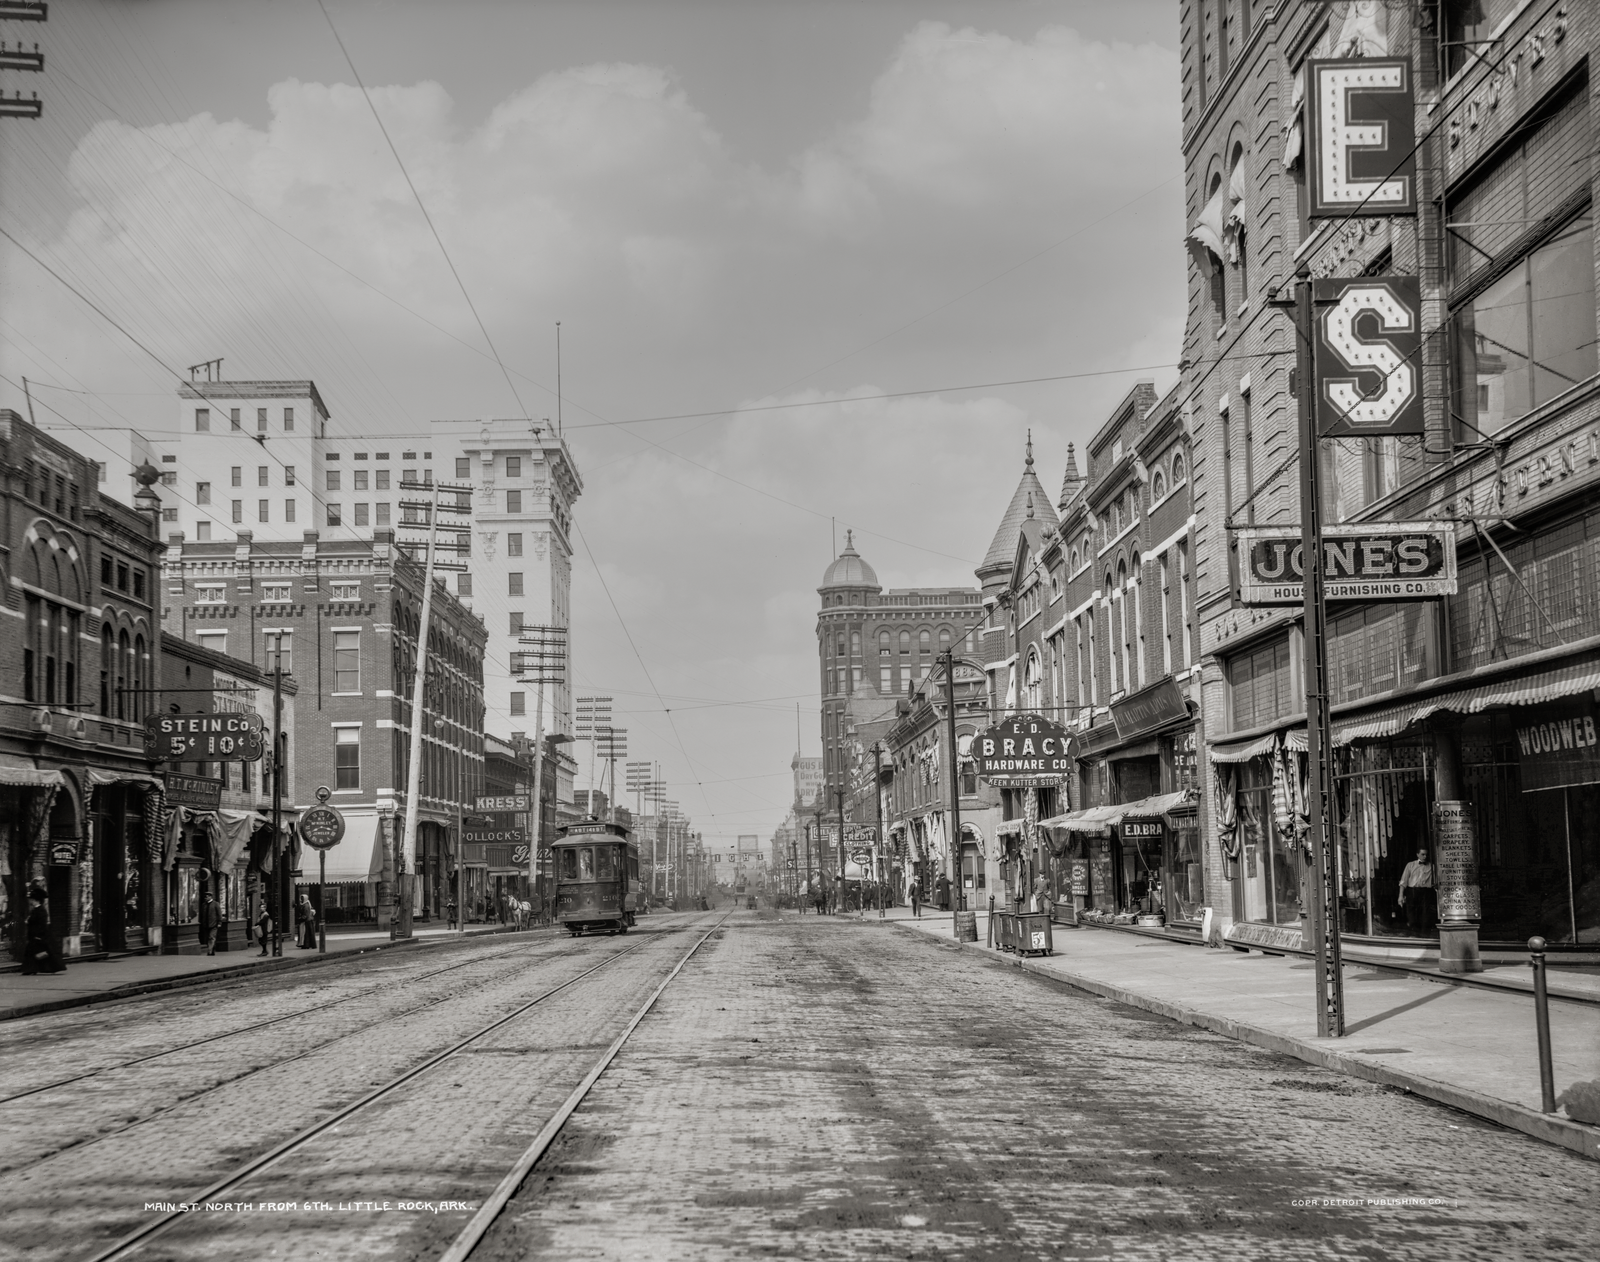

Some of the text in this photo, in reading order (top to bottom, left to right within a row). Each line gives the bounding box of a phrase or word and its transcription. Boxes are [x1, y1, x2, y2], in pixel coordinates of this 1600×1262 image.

[1406, 583, 1426, 593] CO.
[161, 719, 221, 732] STEIN
[170, 736, 244, 755] 5¢ 10¢
[982, 738, 1072, 756] BRACY
[800, 761, 816, 770] GUS
[985, 760, 1071, 770] HARDWARE CO.
[988, 777, 1008, 786] KEEN
[1040, 777, 1063, 786] STORE
[1437, 810, 1472, 818] JONES
